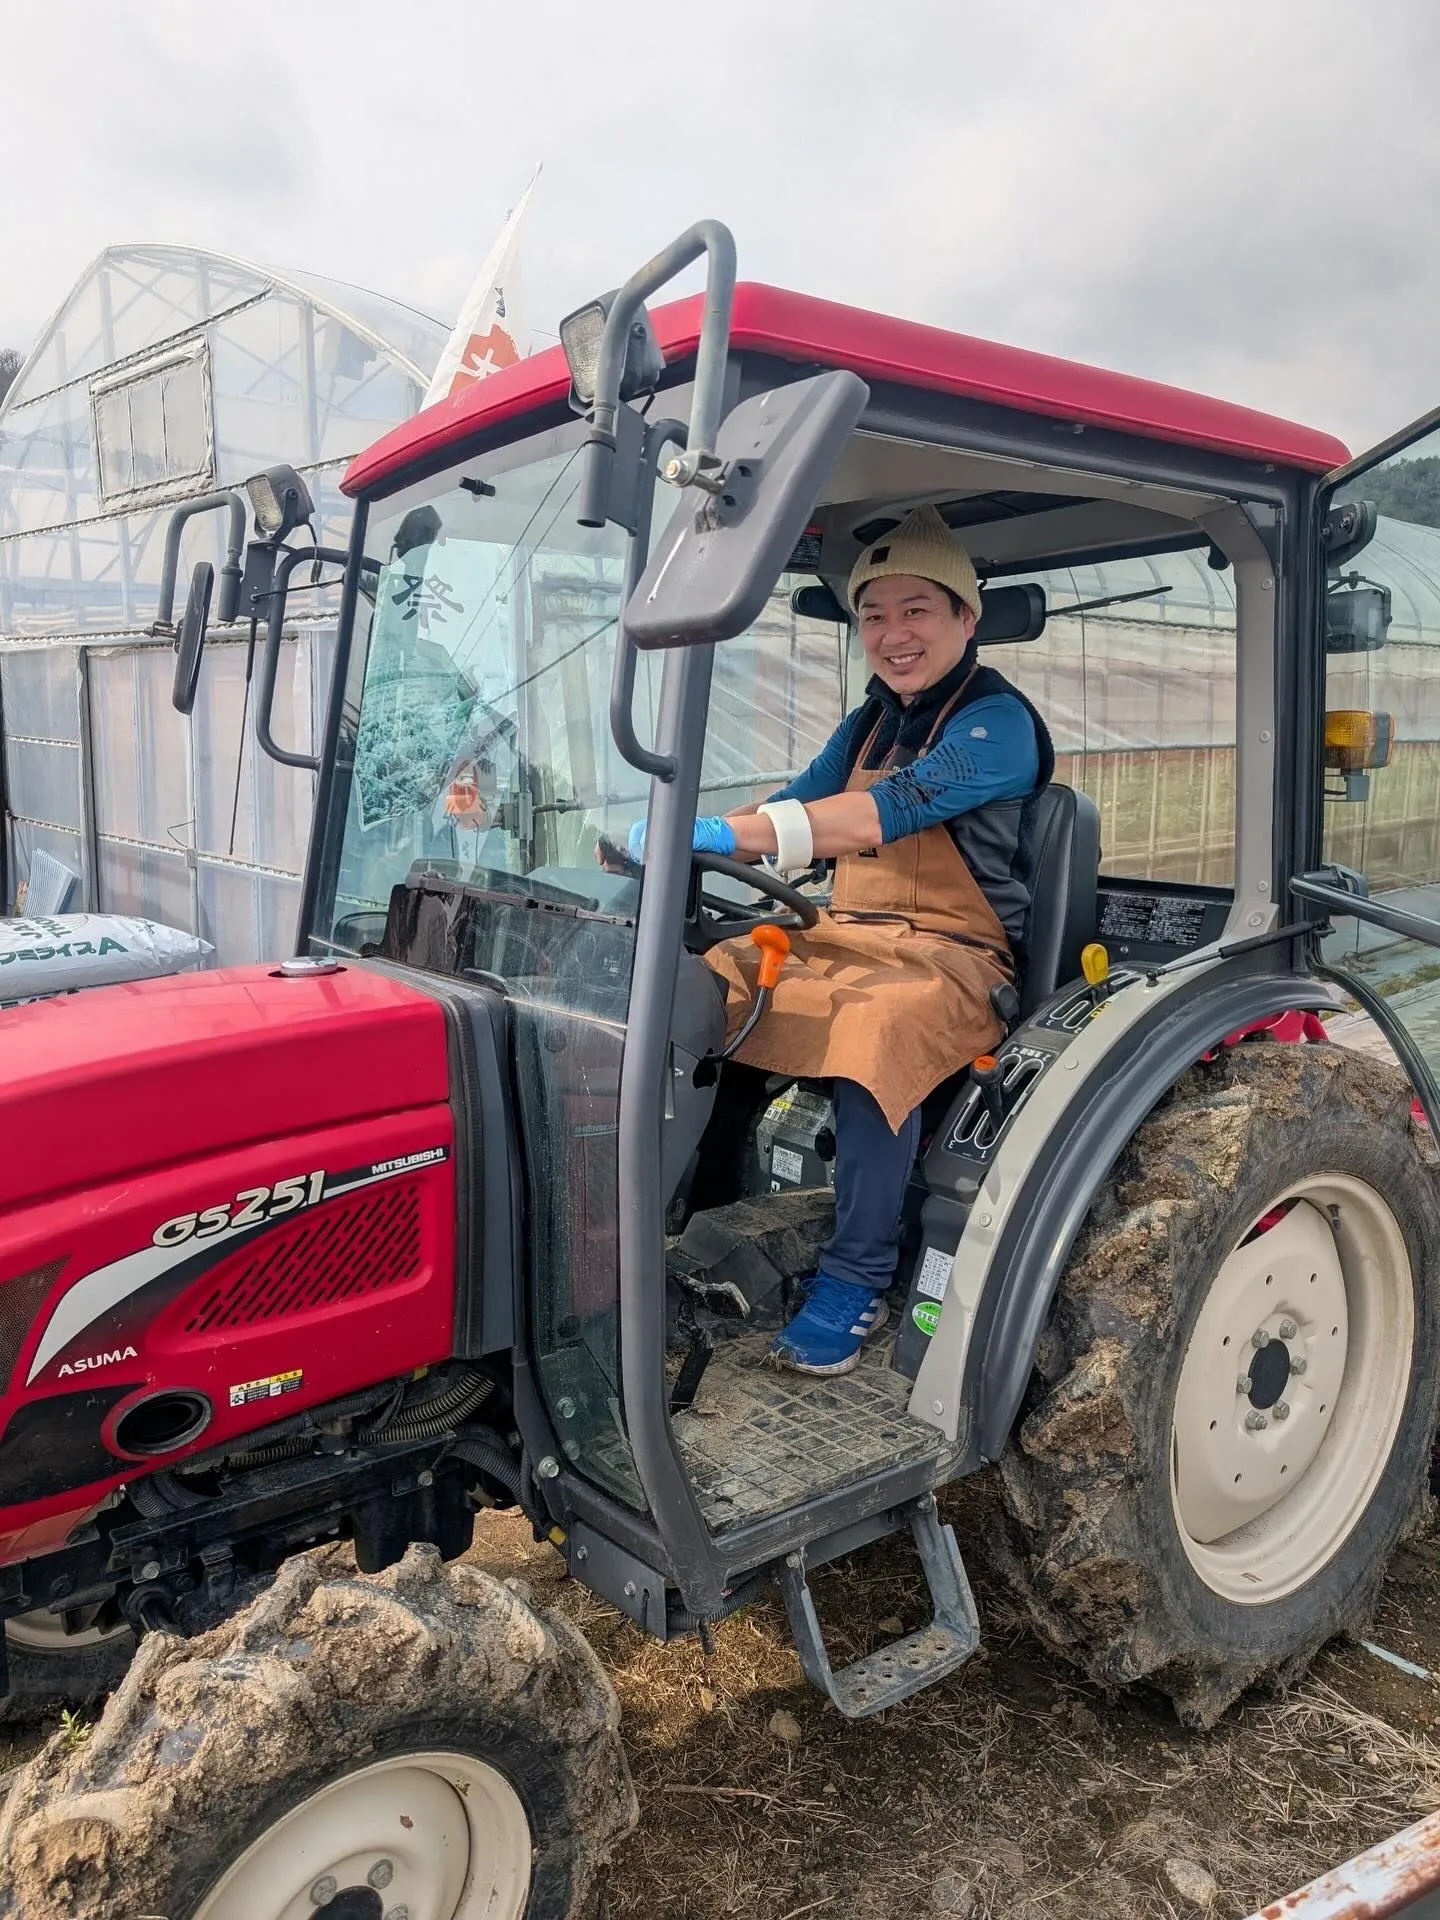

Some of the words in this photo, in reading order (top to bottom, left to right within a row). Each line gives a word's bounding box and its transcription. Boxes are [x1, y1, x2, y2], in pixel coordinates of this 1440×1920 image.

[371, 1147, 444, 1175] MITSUBISHI
[152, 1169, 326, 1247] GS251
[58, 1346, 138, 1378] ASUMA
